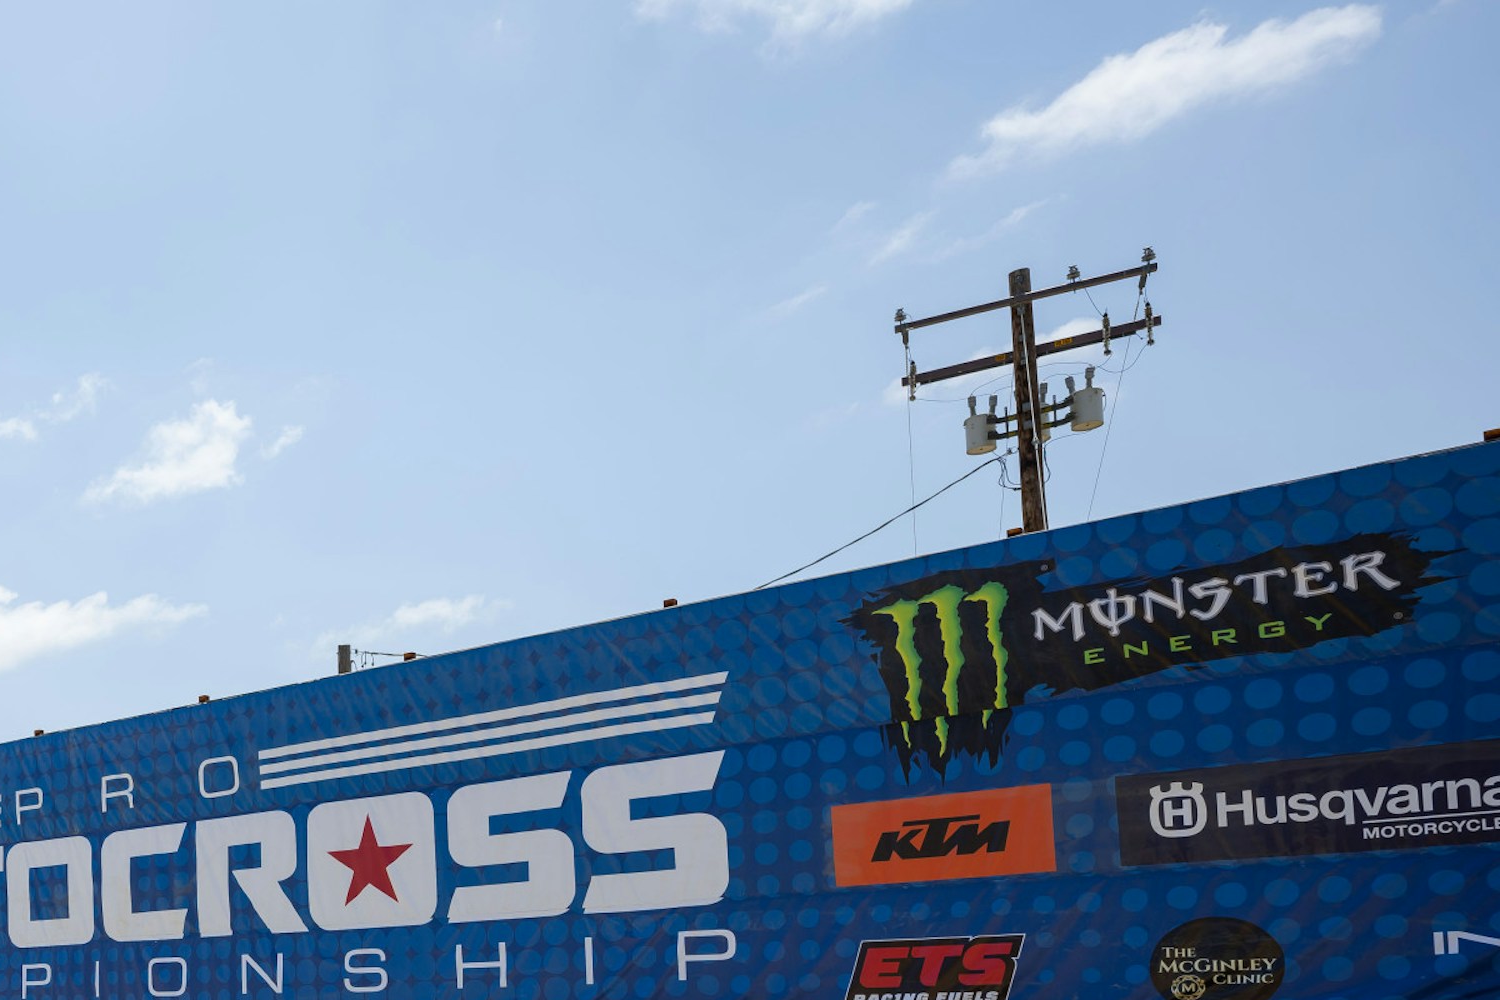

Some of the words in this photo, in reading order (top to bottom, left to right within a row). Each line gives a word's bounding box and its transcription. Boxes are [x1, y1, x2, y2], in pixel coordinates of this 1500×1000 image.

[1031, 550, 1401, 642] MONSTER
[1083, 612, 1333, 666] ENERGY
[14, 756, 241, 825] PRO
[871, 814, 1011, 862] KTM
[859, 942, 1013, 988] ETS
[1161, 946, 1196, 958] THE
[1212, 973, 1275, 985] CLINIC
